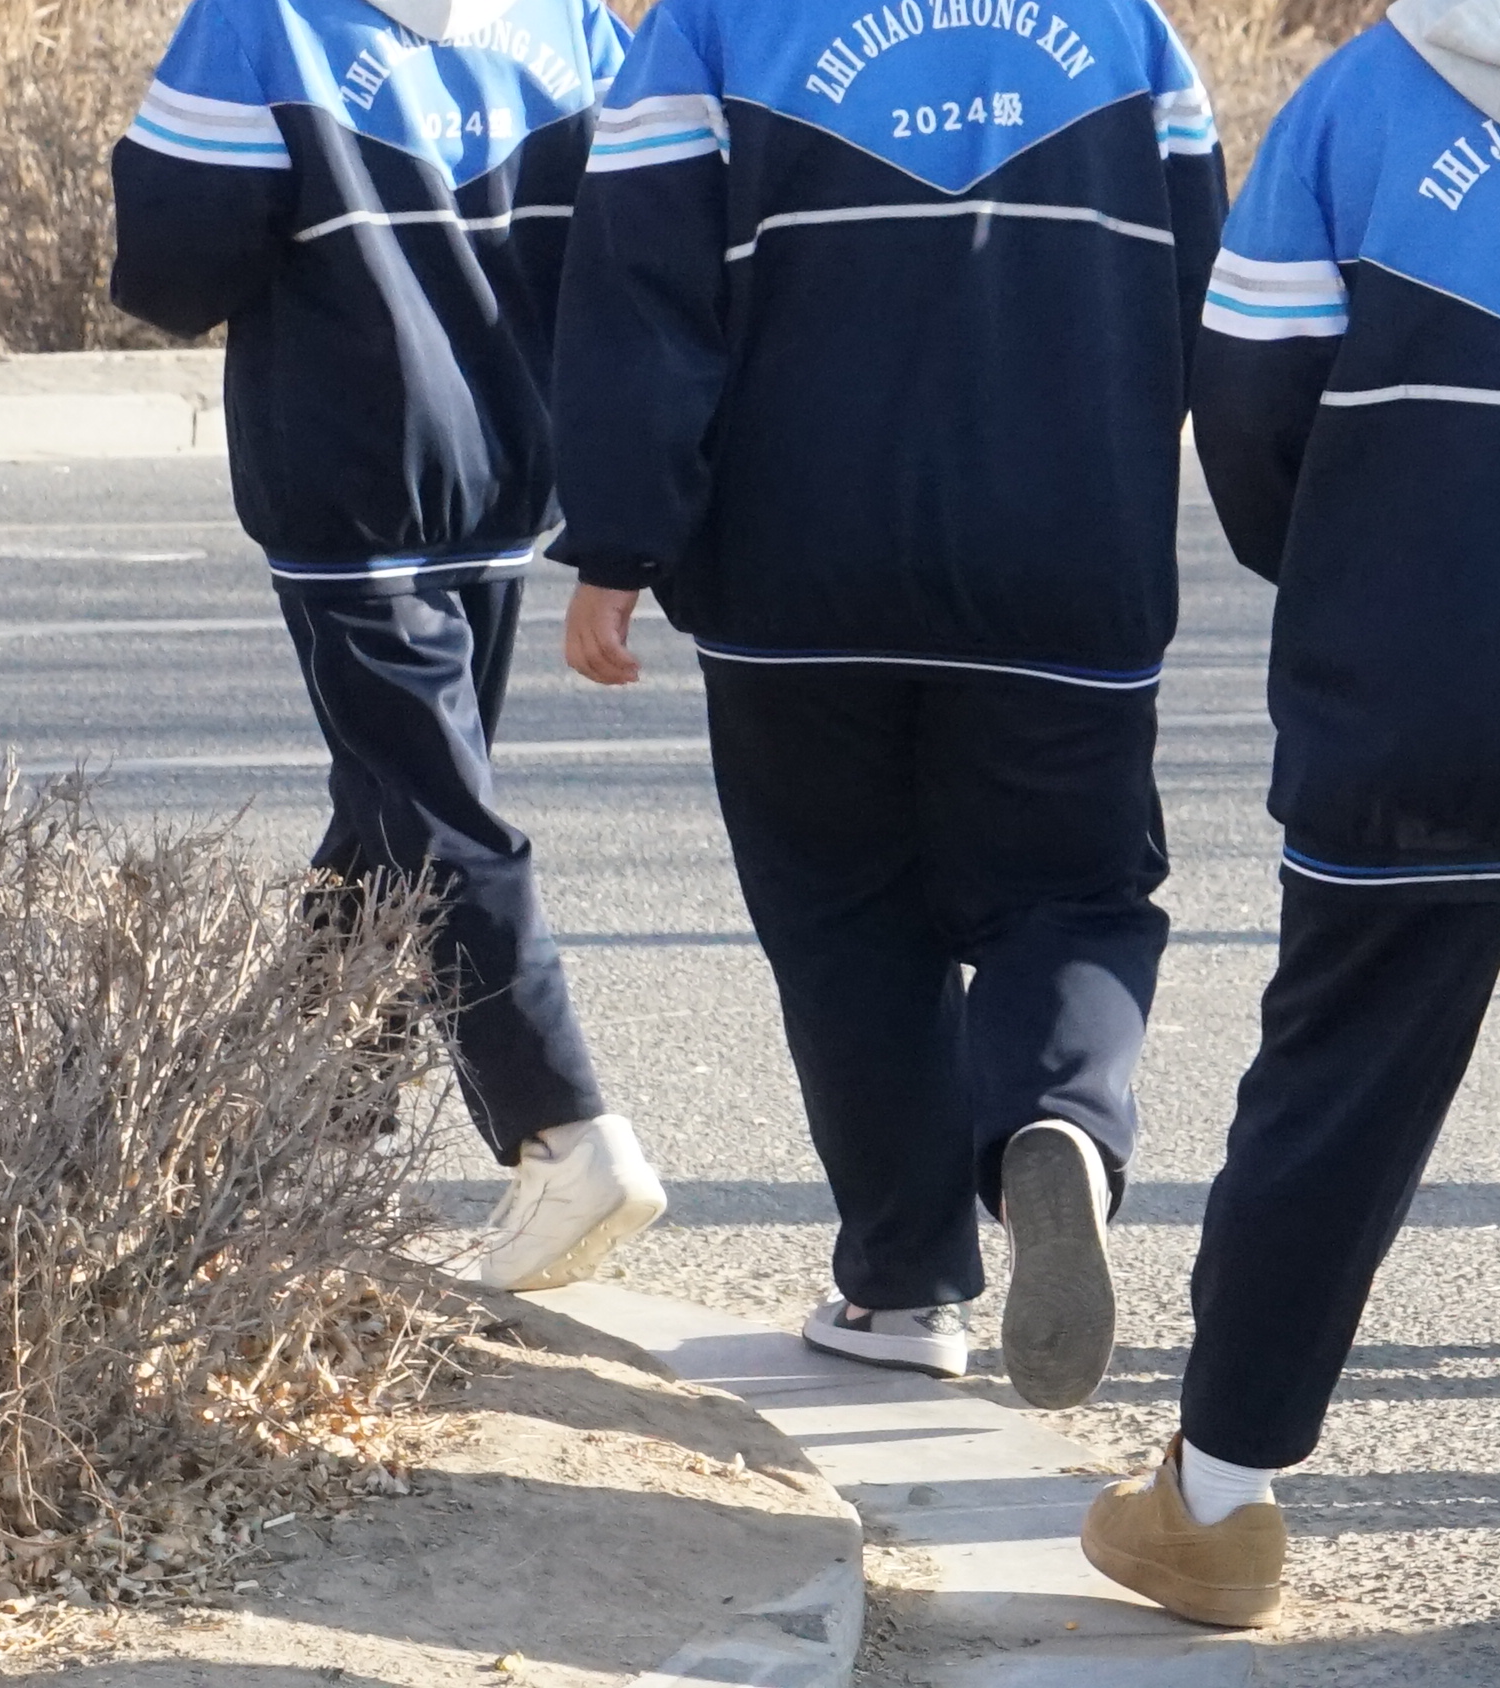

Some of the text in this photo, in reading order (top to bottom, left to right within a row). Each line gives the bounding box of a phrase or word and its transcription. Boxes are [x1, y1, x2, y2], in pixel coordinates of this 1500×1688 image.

[339, 49, 391, 111] ZHI
[529, 41, 582, 101] XIN
[806, 36, 866, 105] ZHI
[1036, 15, 1096, 81] XIN
[892, 90, 1024, 140] 2024级
[1418, 136, 1491, 211] ZHI
